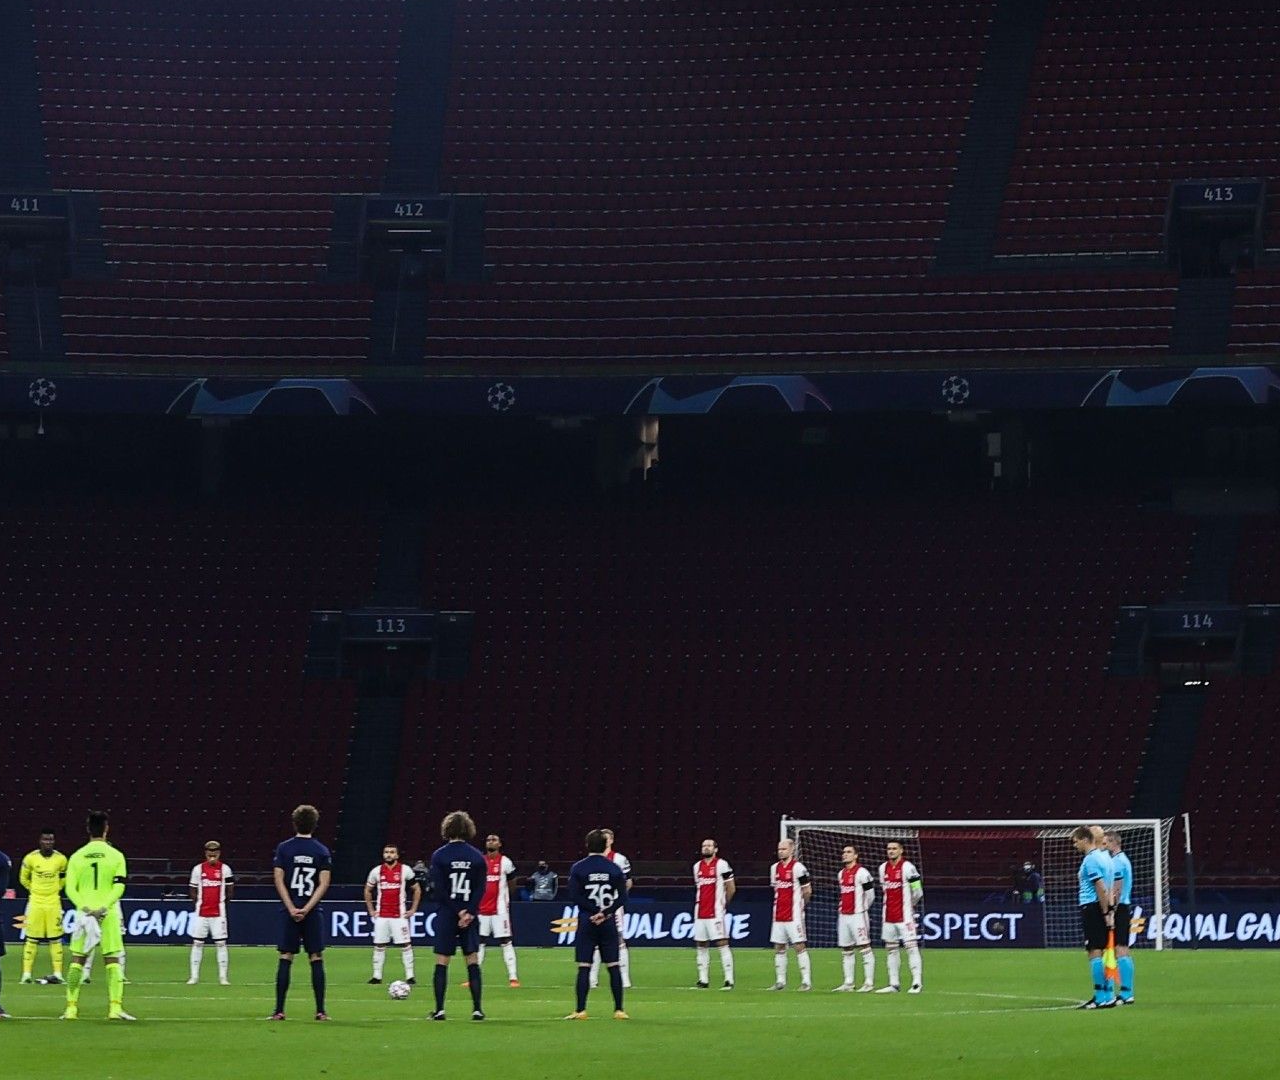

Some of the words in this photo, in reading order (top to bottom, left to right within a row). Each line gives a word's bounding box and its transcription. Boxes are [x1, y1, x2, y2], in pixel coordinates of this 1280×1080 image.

[1203, 187, 1233, 201] 413
[10, 198, 39, 211] 411
[394, 203, 424, 216] 412
[376, 619, 406, 633] 113
[1183, 614, 1213, 628] 114
[90, 862, 99, 890] 1
[290, 867, 317, 897] 43
[449, 872, 471, 902] 14
[584, 883, 613, 911] 36
